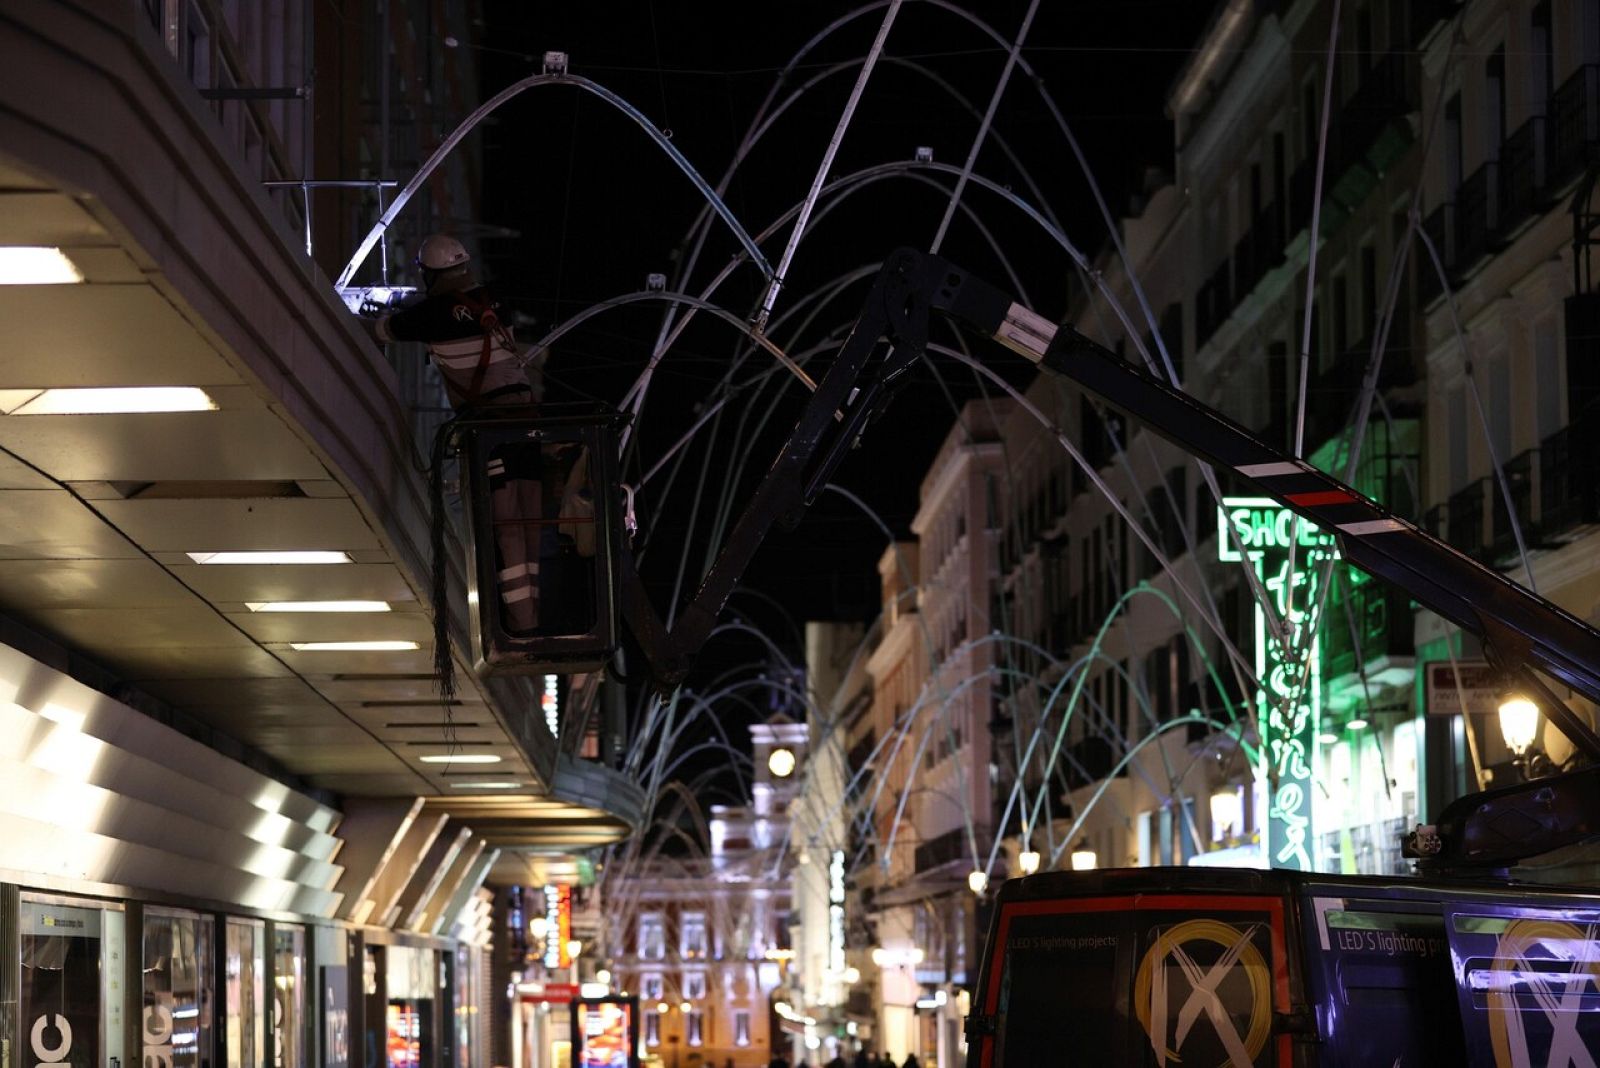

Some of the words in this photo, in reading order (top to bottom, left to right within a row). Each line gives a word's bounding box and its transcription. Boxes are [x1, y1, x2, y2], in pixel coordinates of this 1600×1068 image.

[1230, 509, 1336, 547] SHOE
[1041, 936, 1076, 951] lighting
[1078, 936, 1118, 950] projects
[1377, 931, 1427, 956] lighting
